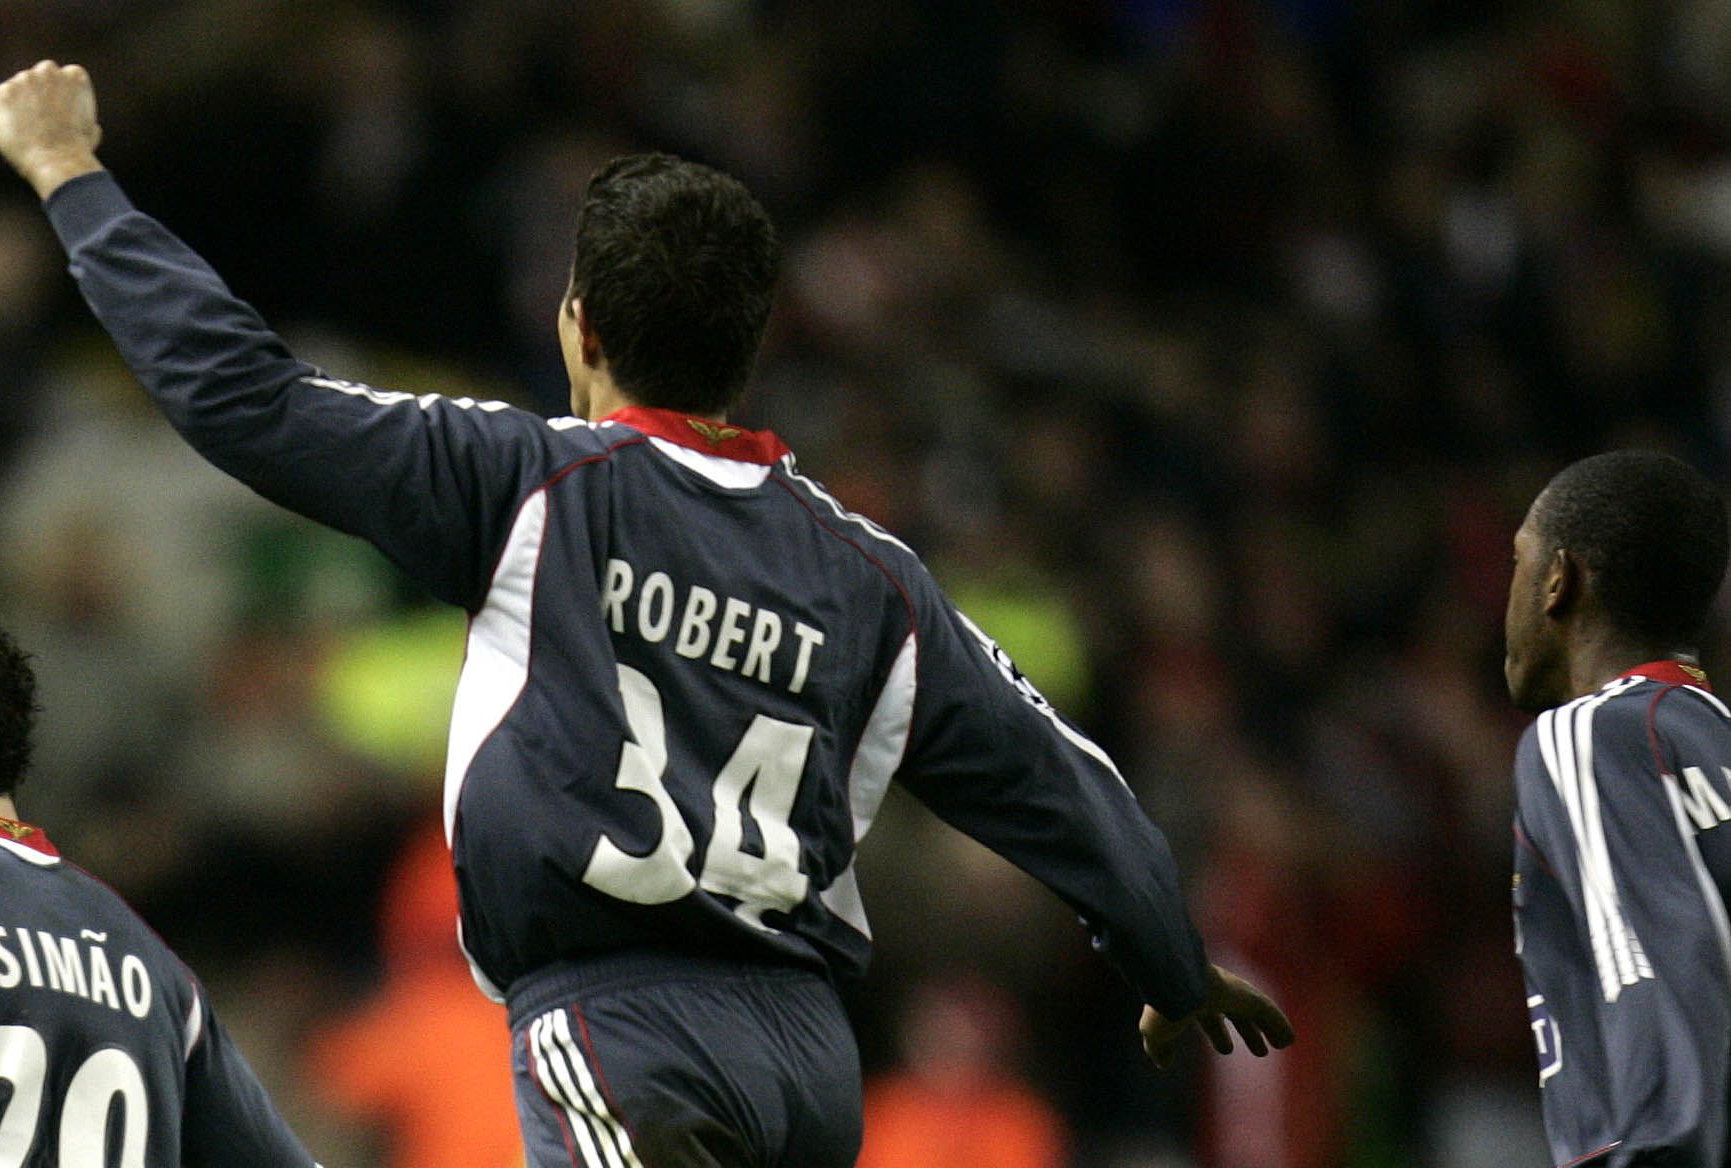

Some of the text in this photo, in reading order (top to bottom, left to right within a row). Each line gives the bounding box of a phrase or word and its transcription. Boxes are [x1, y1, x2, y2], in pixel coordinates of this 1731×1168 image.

[601, 557, 825, 695] ROBERT
[581, 662, 815, 935] 34
[1673, 766, 1731, 835] M
